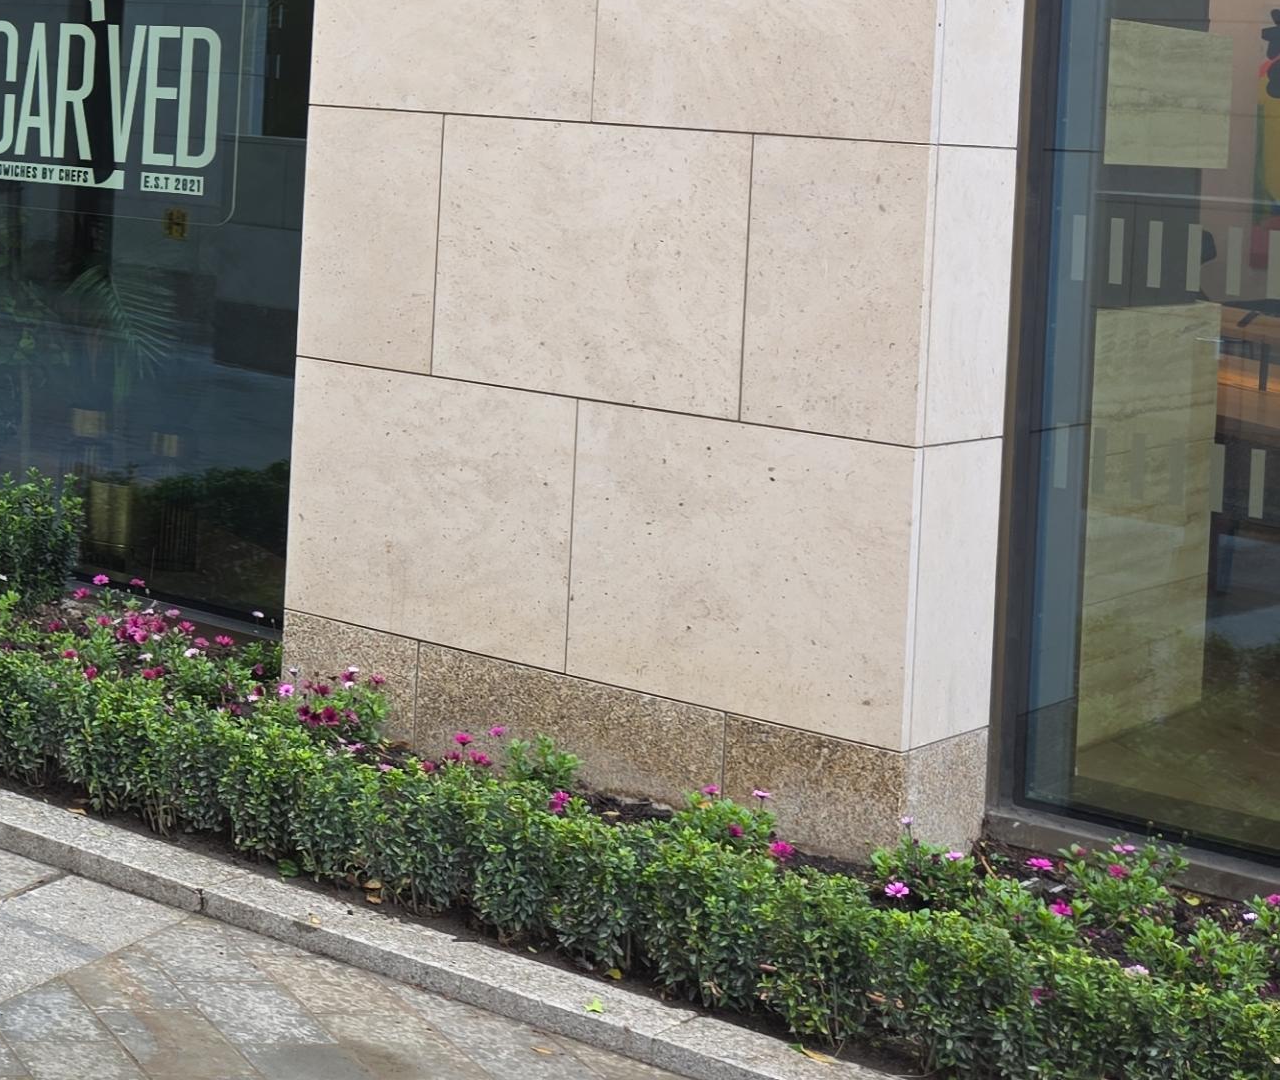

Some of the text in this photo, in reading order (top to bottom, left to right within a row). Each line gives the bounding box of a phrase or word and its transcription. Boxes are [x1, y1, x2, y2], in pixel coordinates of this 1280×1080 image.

[41, 167, 54, 181] BY
[58, 168, 89, 184] CHEFS
[143, 176, 202, 193] E.S.T 2021
